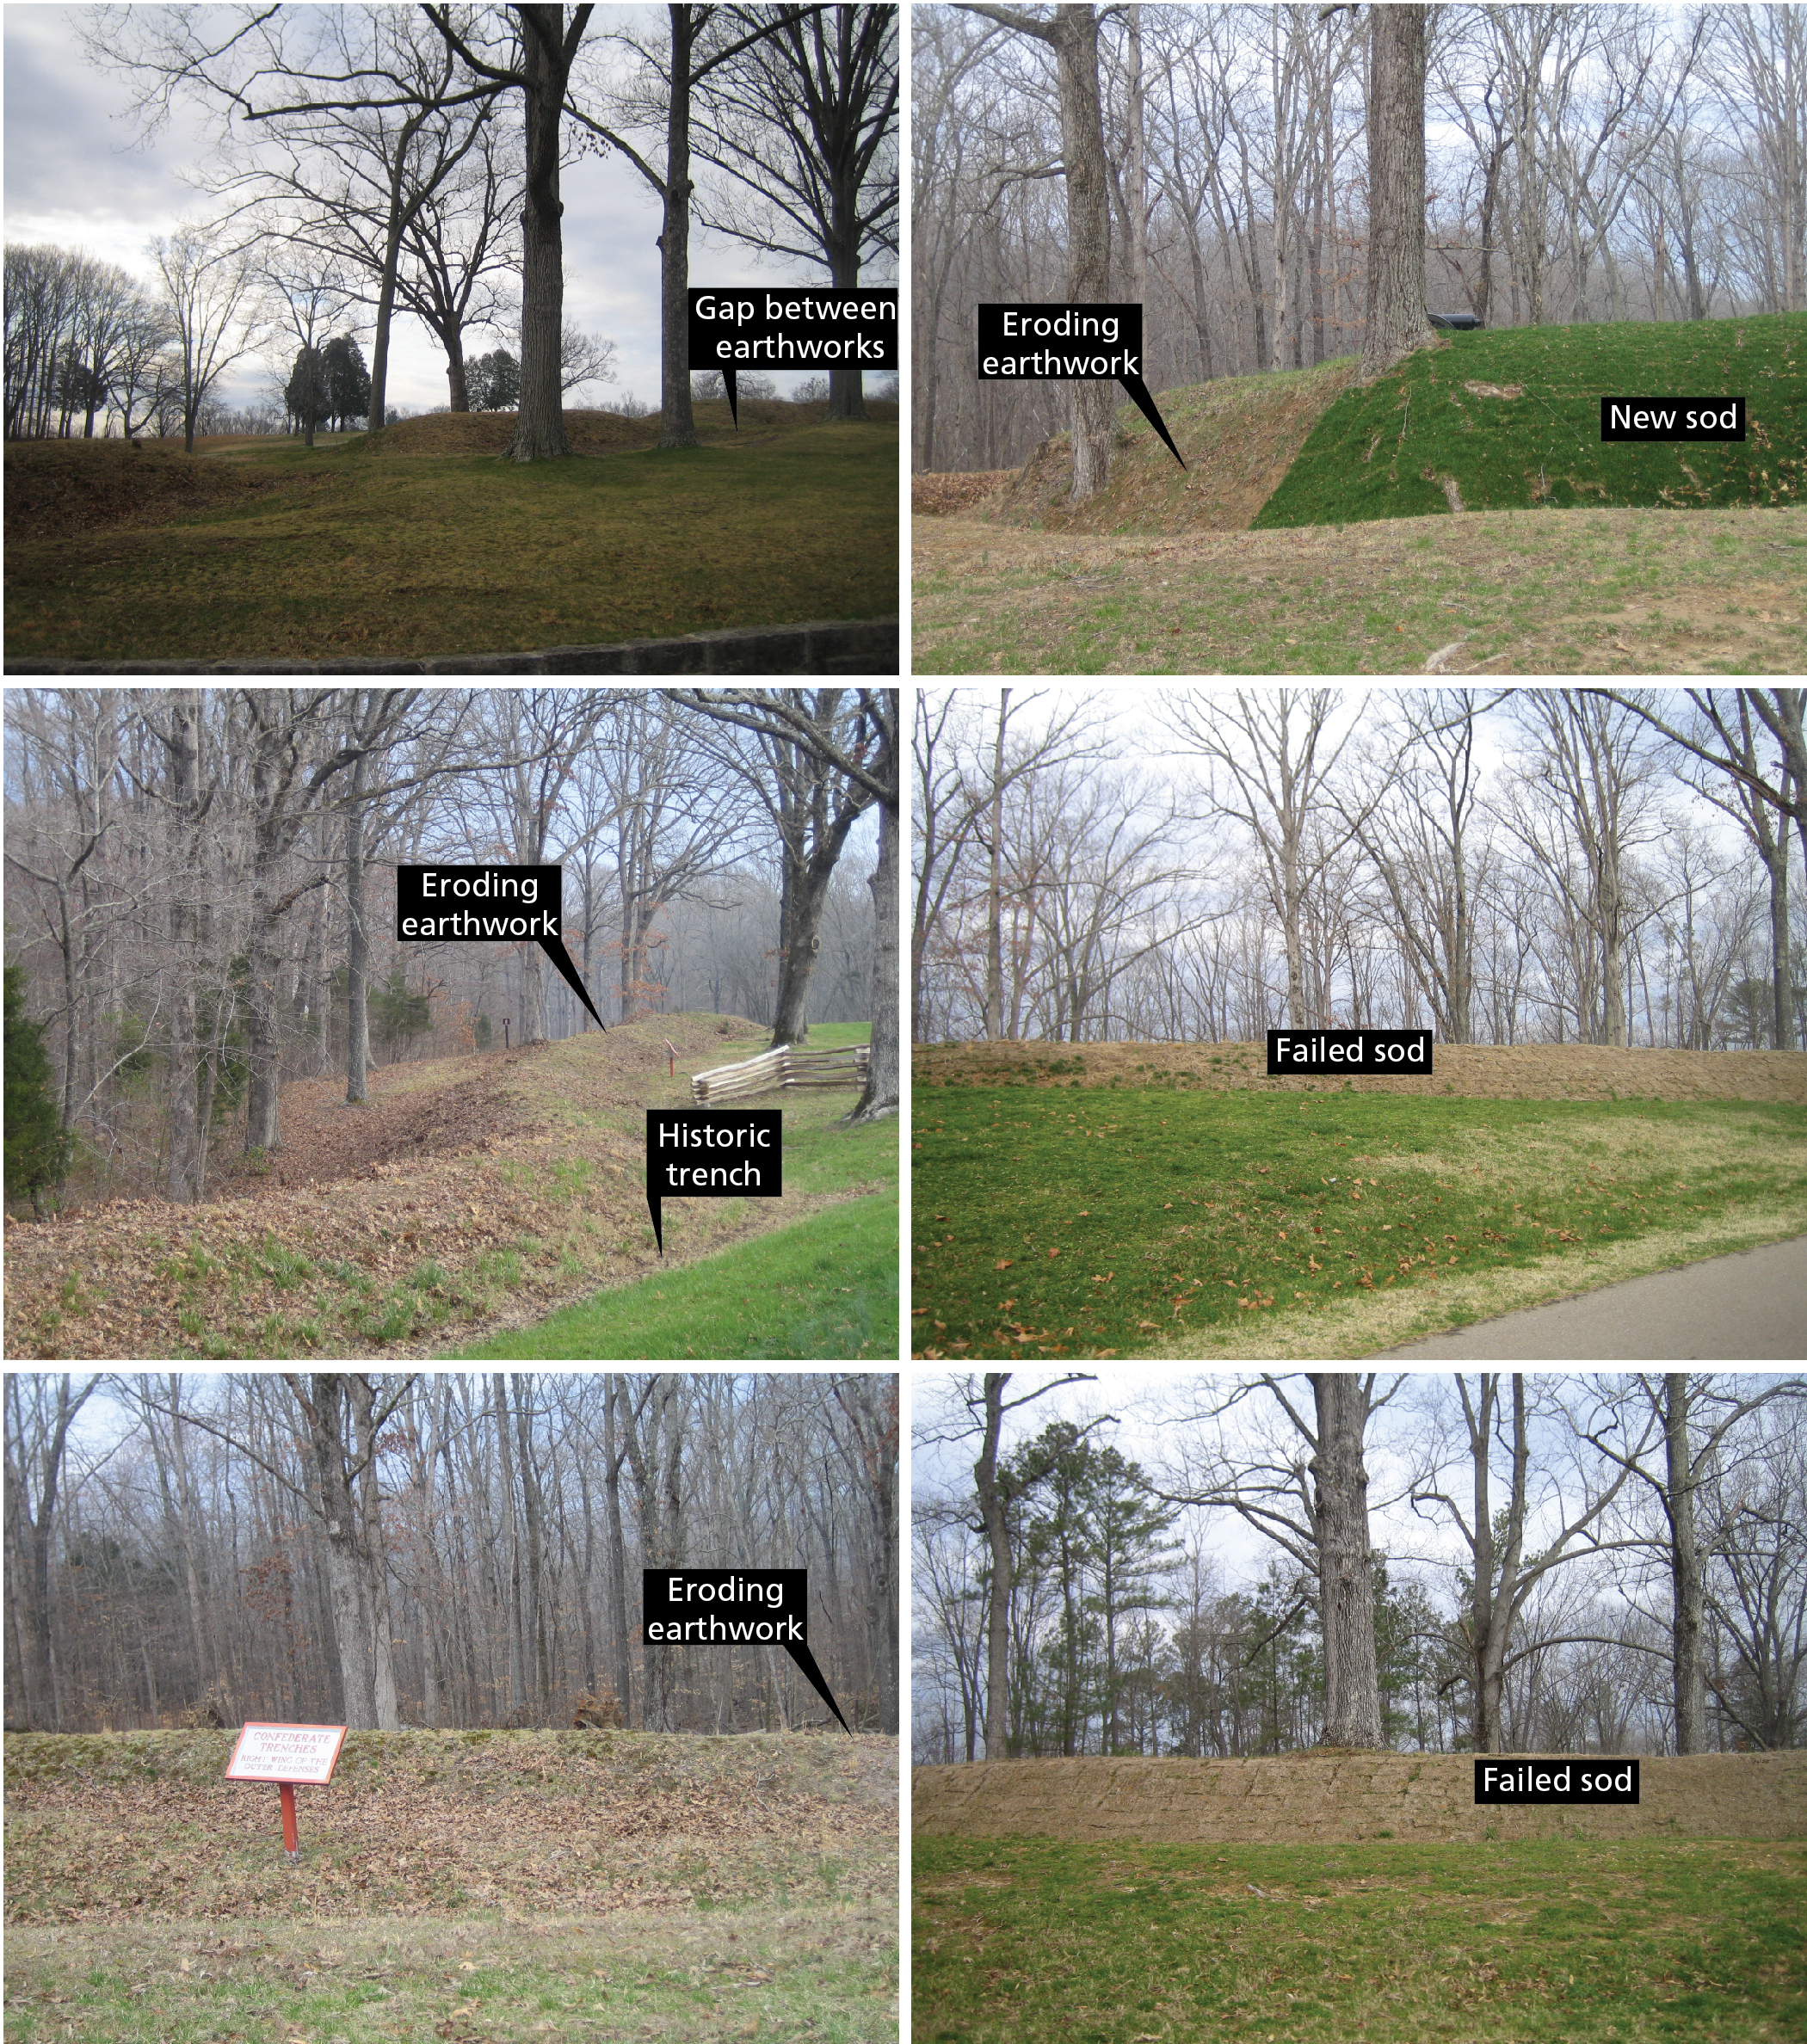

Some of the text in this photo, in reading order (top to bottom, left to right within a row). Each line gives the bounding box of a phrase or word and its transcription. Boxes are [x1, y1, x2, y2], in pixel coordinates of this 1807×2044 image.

[253, 1732, 331, 1744] CONFEDERATE
[260, 1742, 318, 1753] TRENCHES
[240, 1754, 268, 1763] RIGHT
[310, 1758, 329, 1766] THE
[244, 1763, 320, 1773] OUTER DEFENSES
